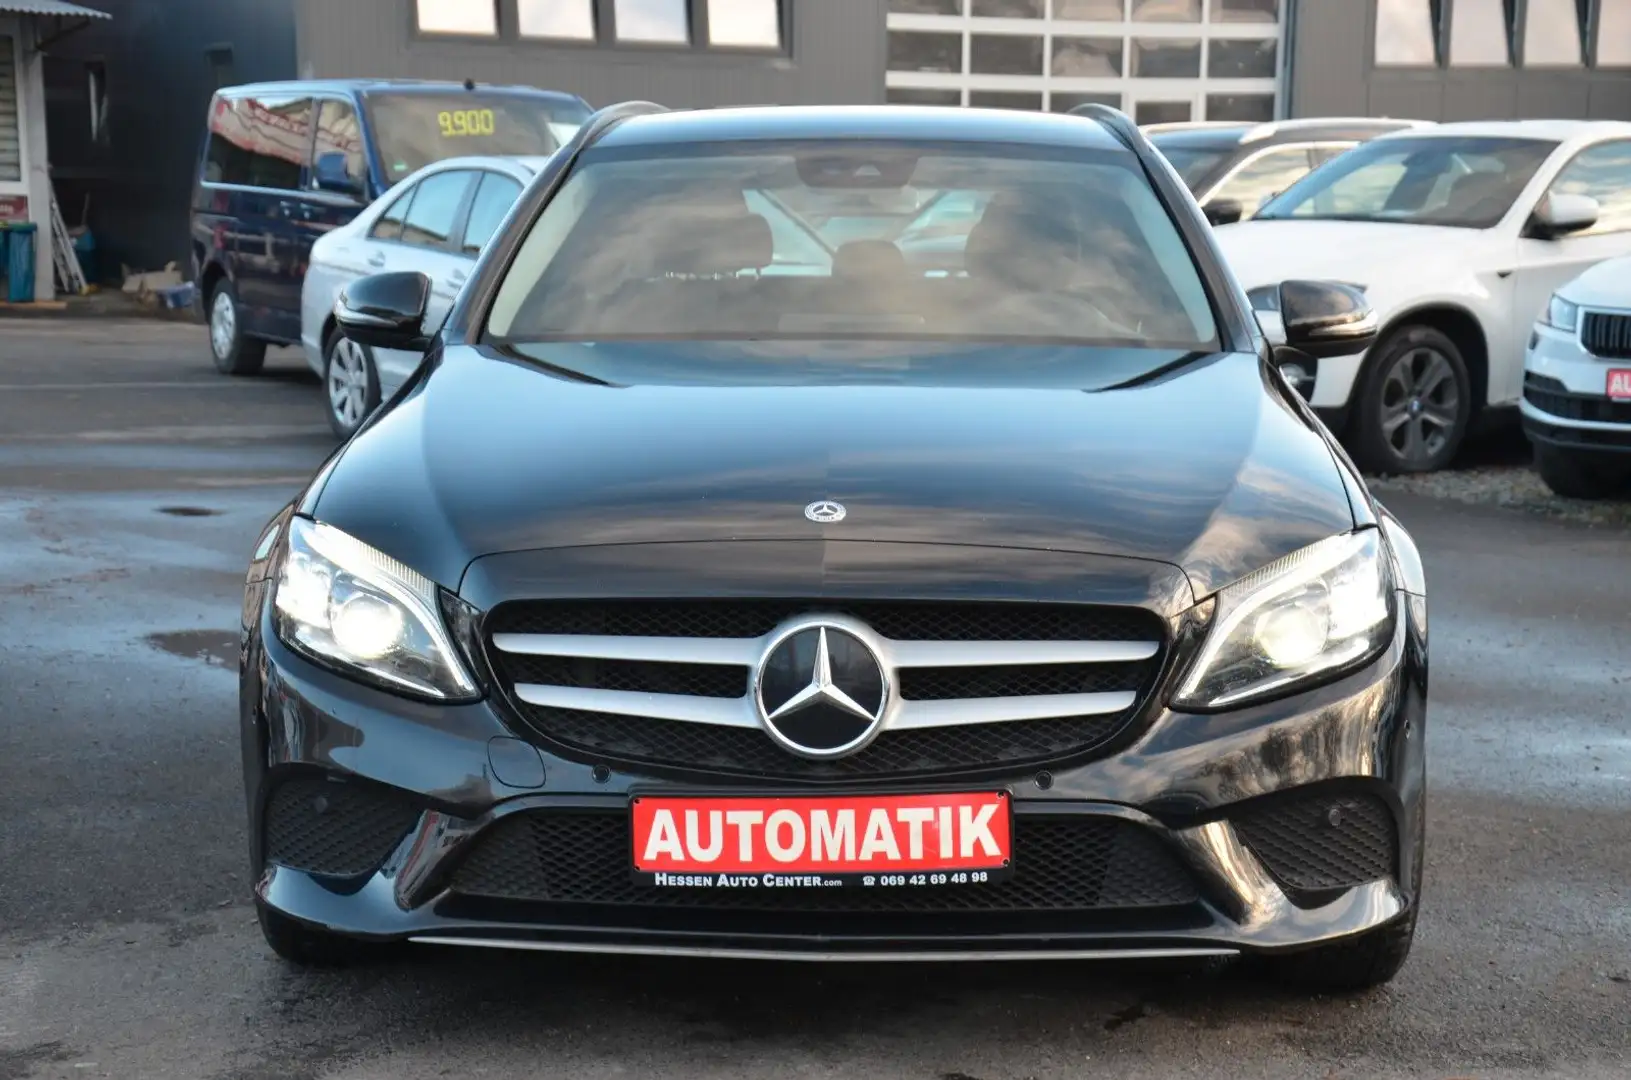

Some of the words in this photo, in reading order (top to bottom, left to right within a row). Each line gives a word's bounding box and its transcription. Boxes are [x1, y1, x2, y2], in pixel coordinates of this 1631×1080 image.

[438, 109, 494, 136] 9.900
[643, 804, 1002, 863] AUTOMATIK
[654, 873, 713, 887] HESSEN
[716, 874, 759, 887] AUTO
[880, 875, 906, 886] 069
[909, 875, 926, 885] 42
[930, 874, 947, 884] 69
[951, 873, 968, 883] 48
[971, 871, 988, 882] 98
